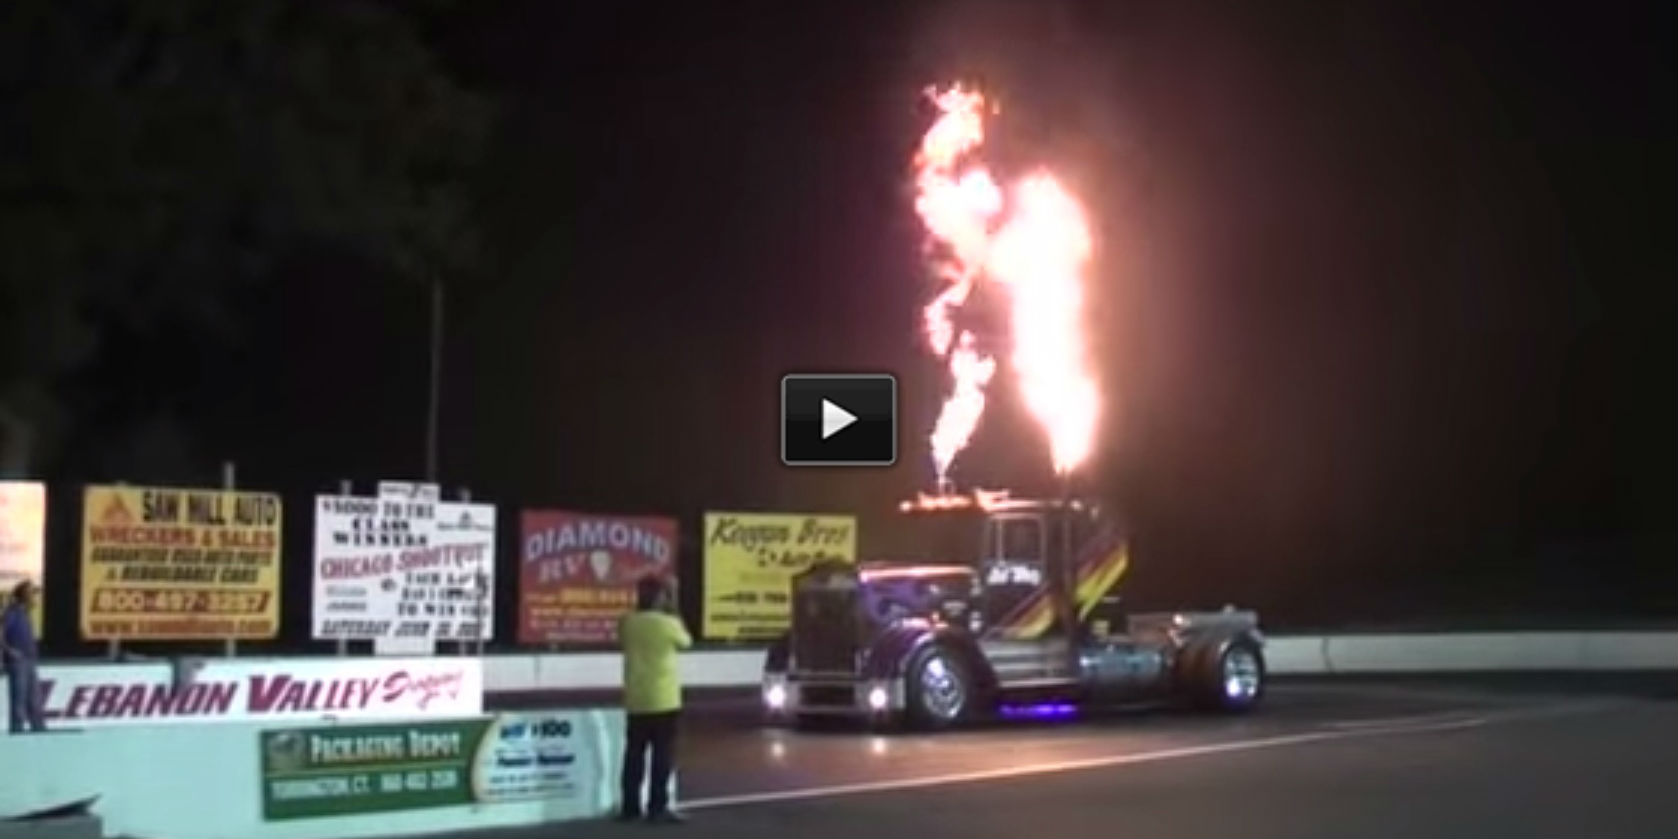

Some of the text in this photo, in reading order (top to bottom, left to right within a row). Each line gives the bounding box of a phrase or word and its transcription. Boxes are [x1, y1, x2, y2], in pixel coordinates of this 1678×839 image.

[142, 490, 276, 526] SAW MILL AUTO
[90, 524, 196, 545] WRECKERS
[218, 529, 276, 548] SALES
[525, 521, 671, 563] DIAMOND
[321, 553, 394, 579] CHICAGO
[39, 681, 238, 719] LEBANON
[247, 675, 379, 713] VALLEY
[407, 731, 461, 757] DEPOT
